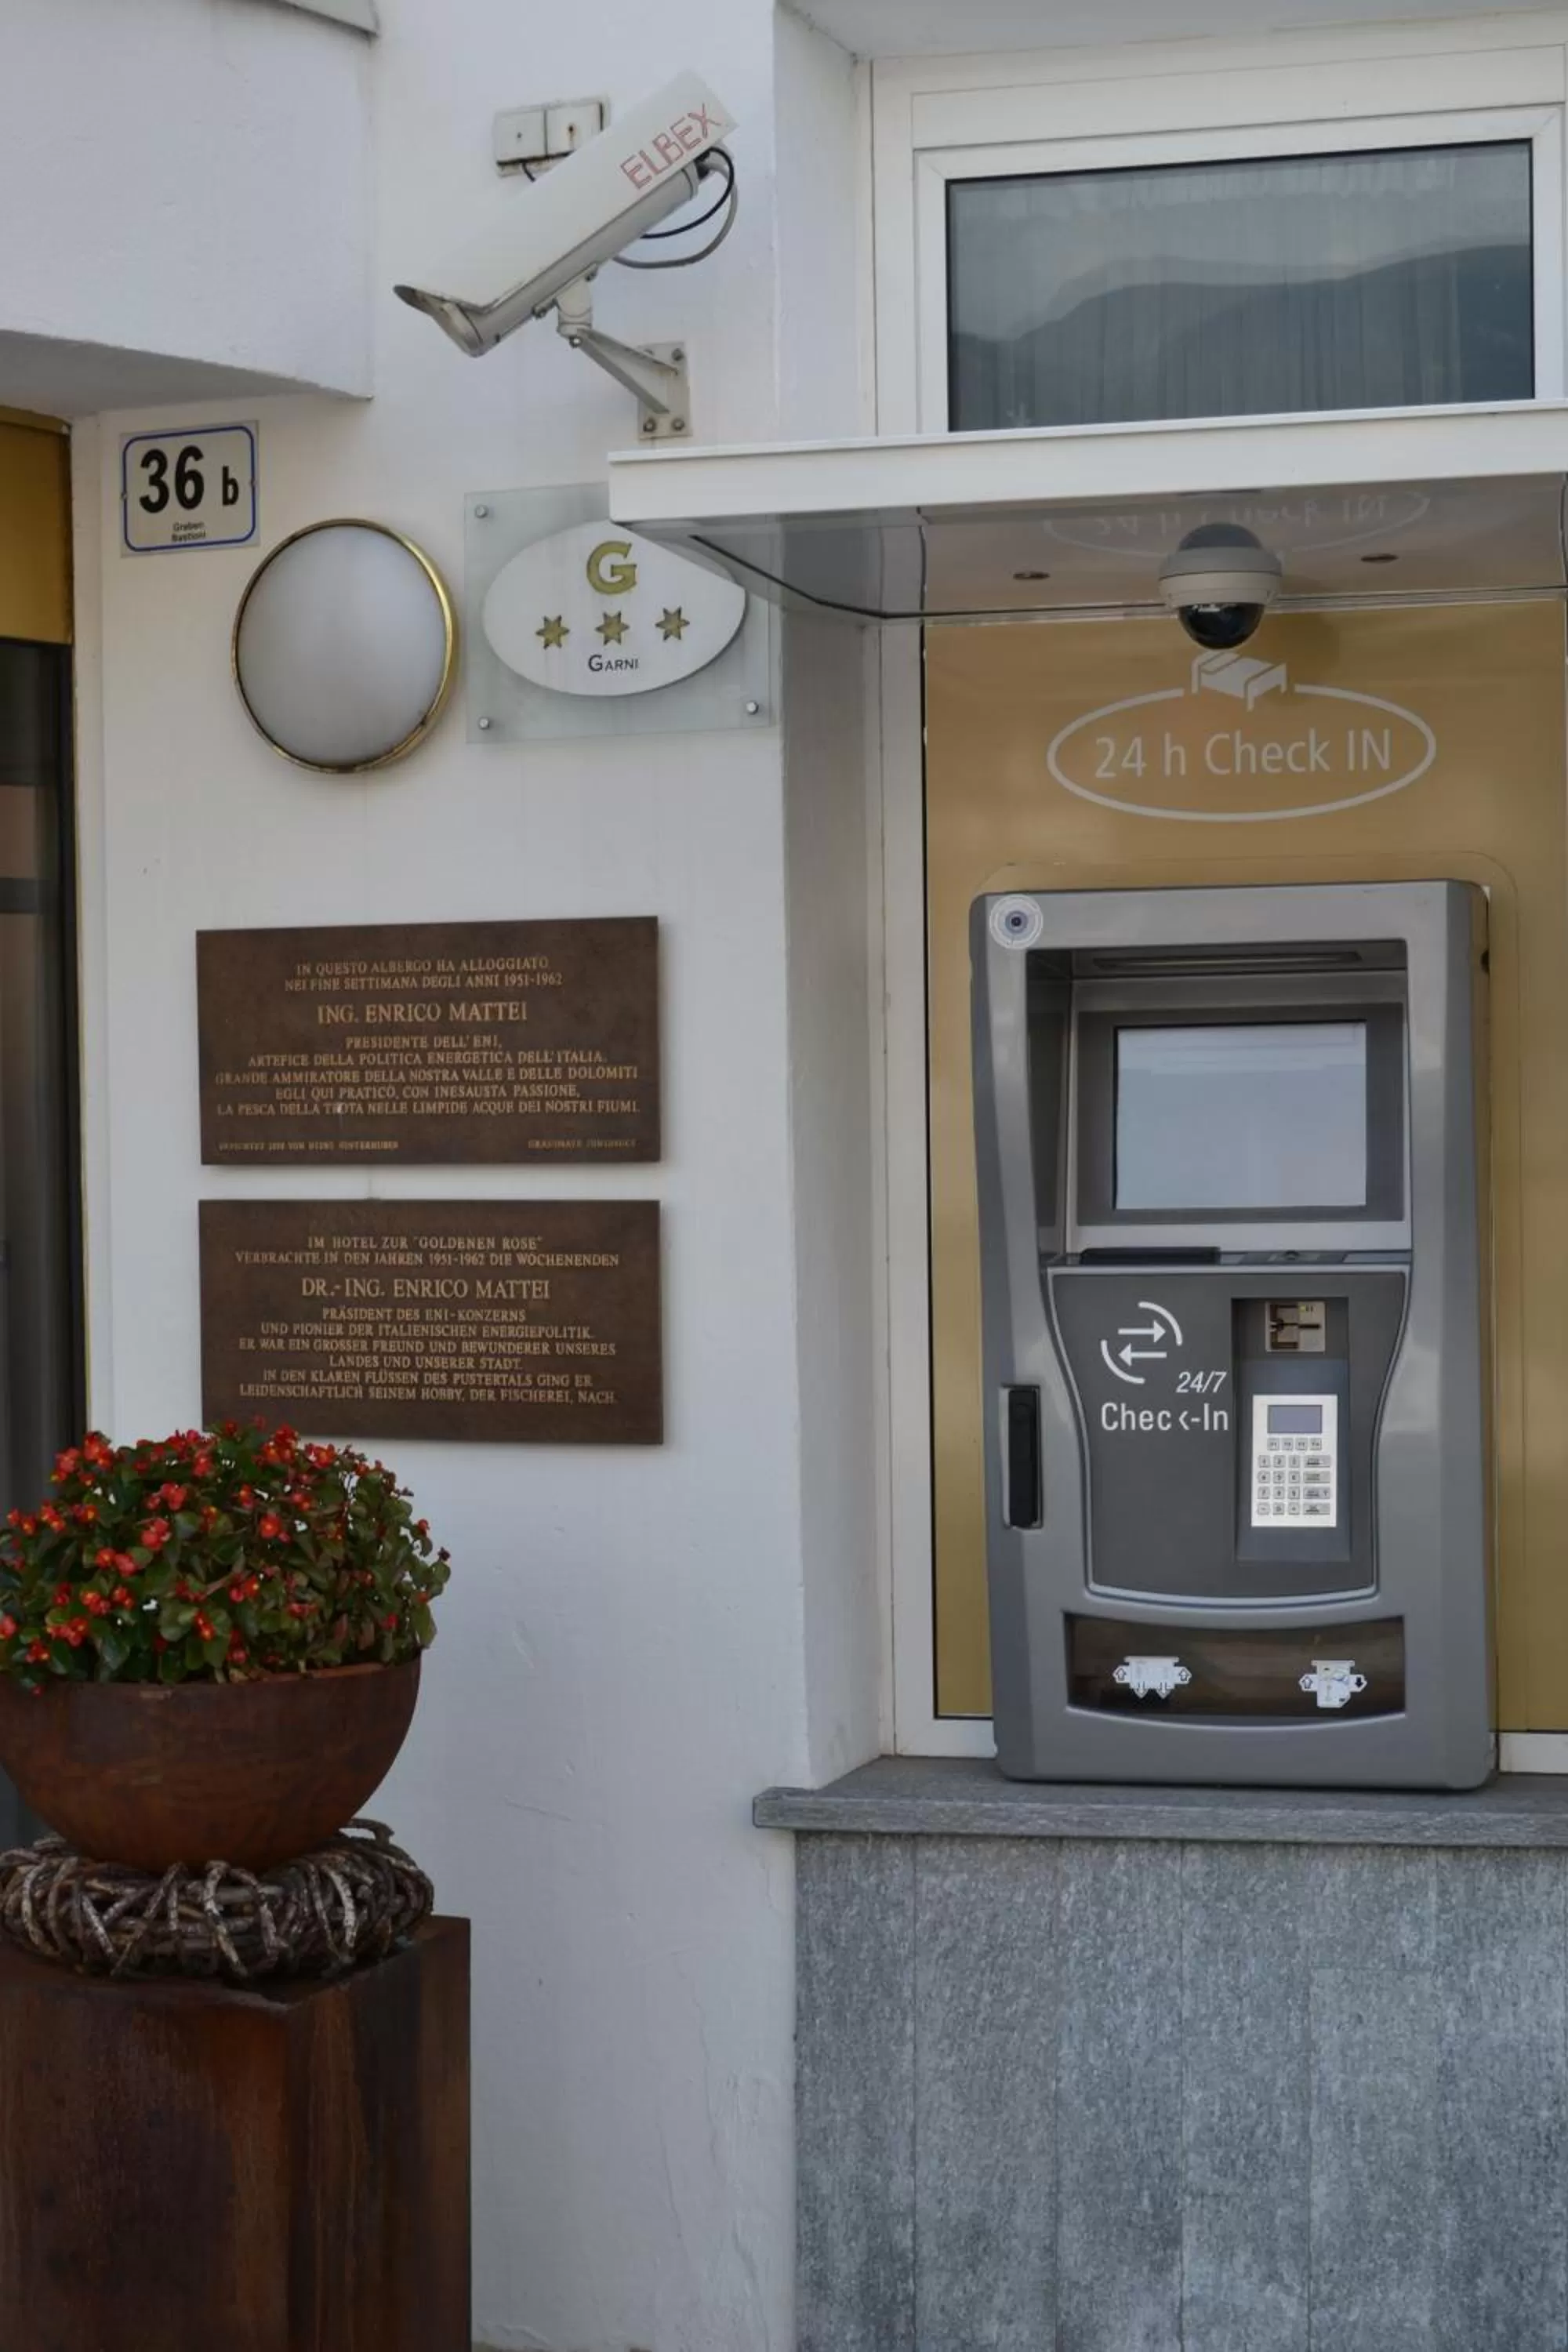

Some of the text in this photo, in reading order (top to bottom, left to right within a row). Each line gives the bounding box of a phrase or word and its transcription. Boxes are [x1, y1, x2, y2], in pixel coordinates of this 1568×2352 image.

[620, 103, 721, 190] ELBEX
[140, 445, 239, 513] 36 b
[586, 541, 637, 594] G
[1094, 728, 1391, 779] 24 h Check IN
[297, 956, 549, 976] IN QUESTO ALBERGO HA ALLOGGIATO
[310, 979, 340, 991] FINE
[344, 976, 418, 990] SETTIMANA
[423, 975, 461, 988] DEGLI
[466, 974, 499, 987] ANNI
[505, 972, 563, 986] 1951-1962
[318, 1001, 527, 1025] ING. ENRICO MATTEI
[346, 1036, 427, 1049] PRESIDENTE
[249, 1054, 309, 1067] ARTEFICE
[314, 1054, 354, 1066] DELLA
[360, 1052, 422, 1065] POLITICA
[427, 1051, 512, 1064] ENERGETICA
[273, 1071, 360, 1083] AMMIRATORE
[365, 1070, 405, 1083] DELLA
[409, 1069, 459, 1081] NOSTRA
[463, 1068, 502, 1080] VALLE
[508, 1068, 514, 1080] E
[520, 1066, 562, 1080] DELLE
[275, 1087, 305, 1100] EGLI
[310, 1087, 333, 1101] QUI
[403, 1086, 429, 1098] CON
[435, 1084, 507, 1098] INESAUSTA
[217, 1104, 233, 1115] LA
[238, 1103, 275, 1115] PESCA
[280, 1102, 320, 1114] DELLA
[368, 1102, 408, 1114] NELLE
[413, 1102, 467, 1114] LIMPIDE
[473, 1101, 514, 1115] ACQUE
[518, 1101, 540, 1112] DEI
[546, 1100, 592, 1112] NOSTRI
[307, 1236, 325, 1248] IM
[332, 1236, 378, 1248] HOTEL
[382, 1236, 408, 1249] ZUR
[324, 1252, 338, 1264] IN
[344, 1252, 369, 1265] DEN
[374, 1253, 423, 1265] JAHREN
[430, 1253, 485, 1265] 1951-1962
[490, 1254, 511, 1266] DIE
[517, 1254, 619, 1267] WOCHENENDEN
[394, 1278, 469, 1298] ENRICO
[476, 1279, 550, 1299] MATTEI
[323, 1306, 391, 1320] PRÄSIDENT
[397, 1308, 419, 1320] DES
[261, 1323, 288, 1334] UND
[293, 1323, 343, 1335] PIONIER
[349, 1324, 373, 1336] DER
[379, 1324, 477, 1337] ITALIENISCHEN
[239, 1338, 615, 1356] ER WAR EIN GROSSER FREUND UND BEWUNDERER UNSERES
[329, 1356, 379, 1368] LANDES
[383, 1356, 411, 1368] UND
[416, 1356, 476, 1369] UNSERER
[263, 1370, 592, 1387] IN DEN KLAREN FLÜSSEN DES PUSTERTALS GING ER
[1176, 1371, 1227, 1393] 24/7
[368, 1387, 416, 1399] SEINEM
[471, 1389, 495, 1401] DER
